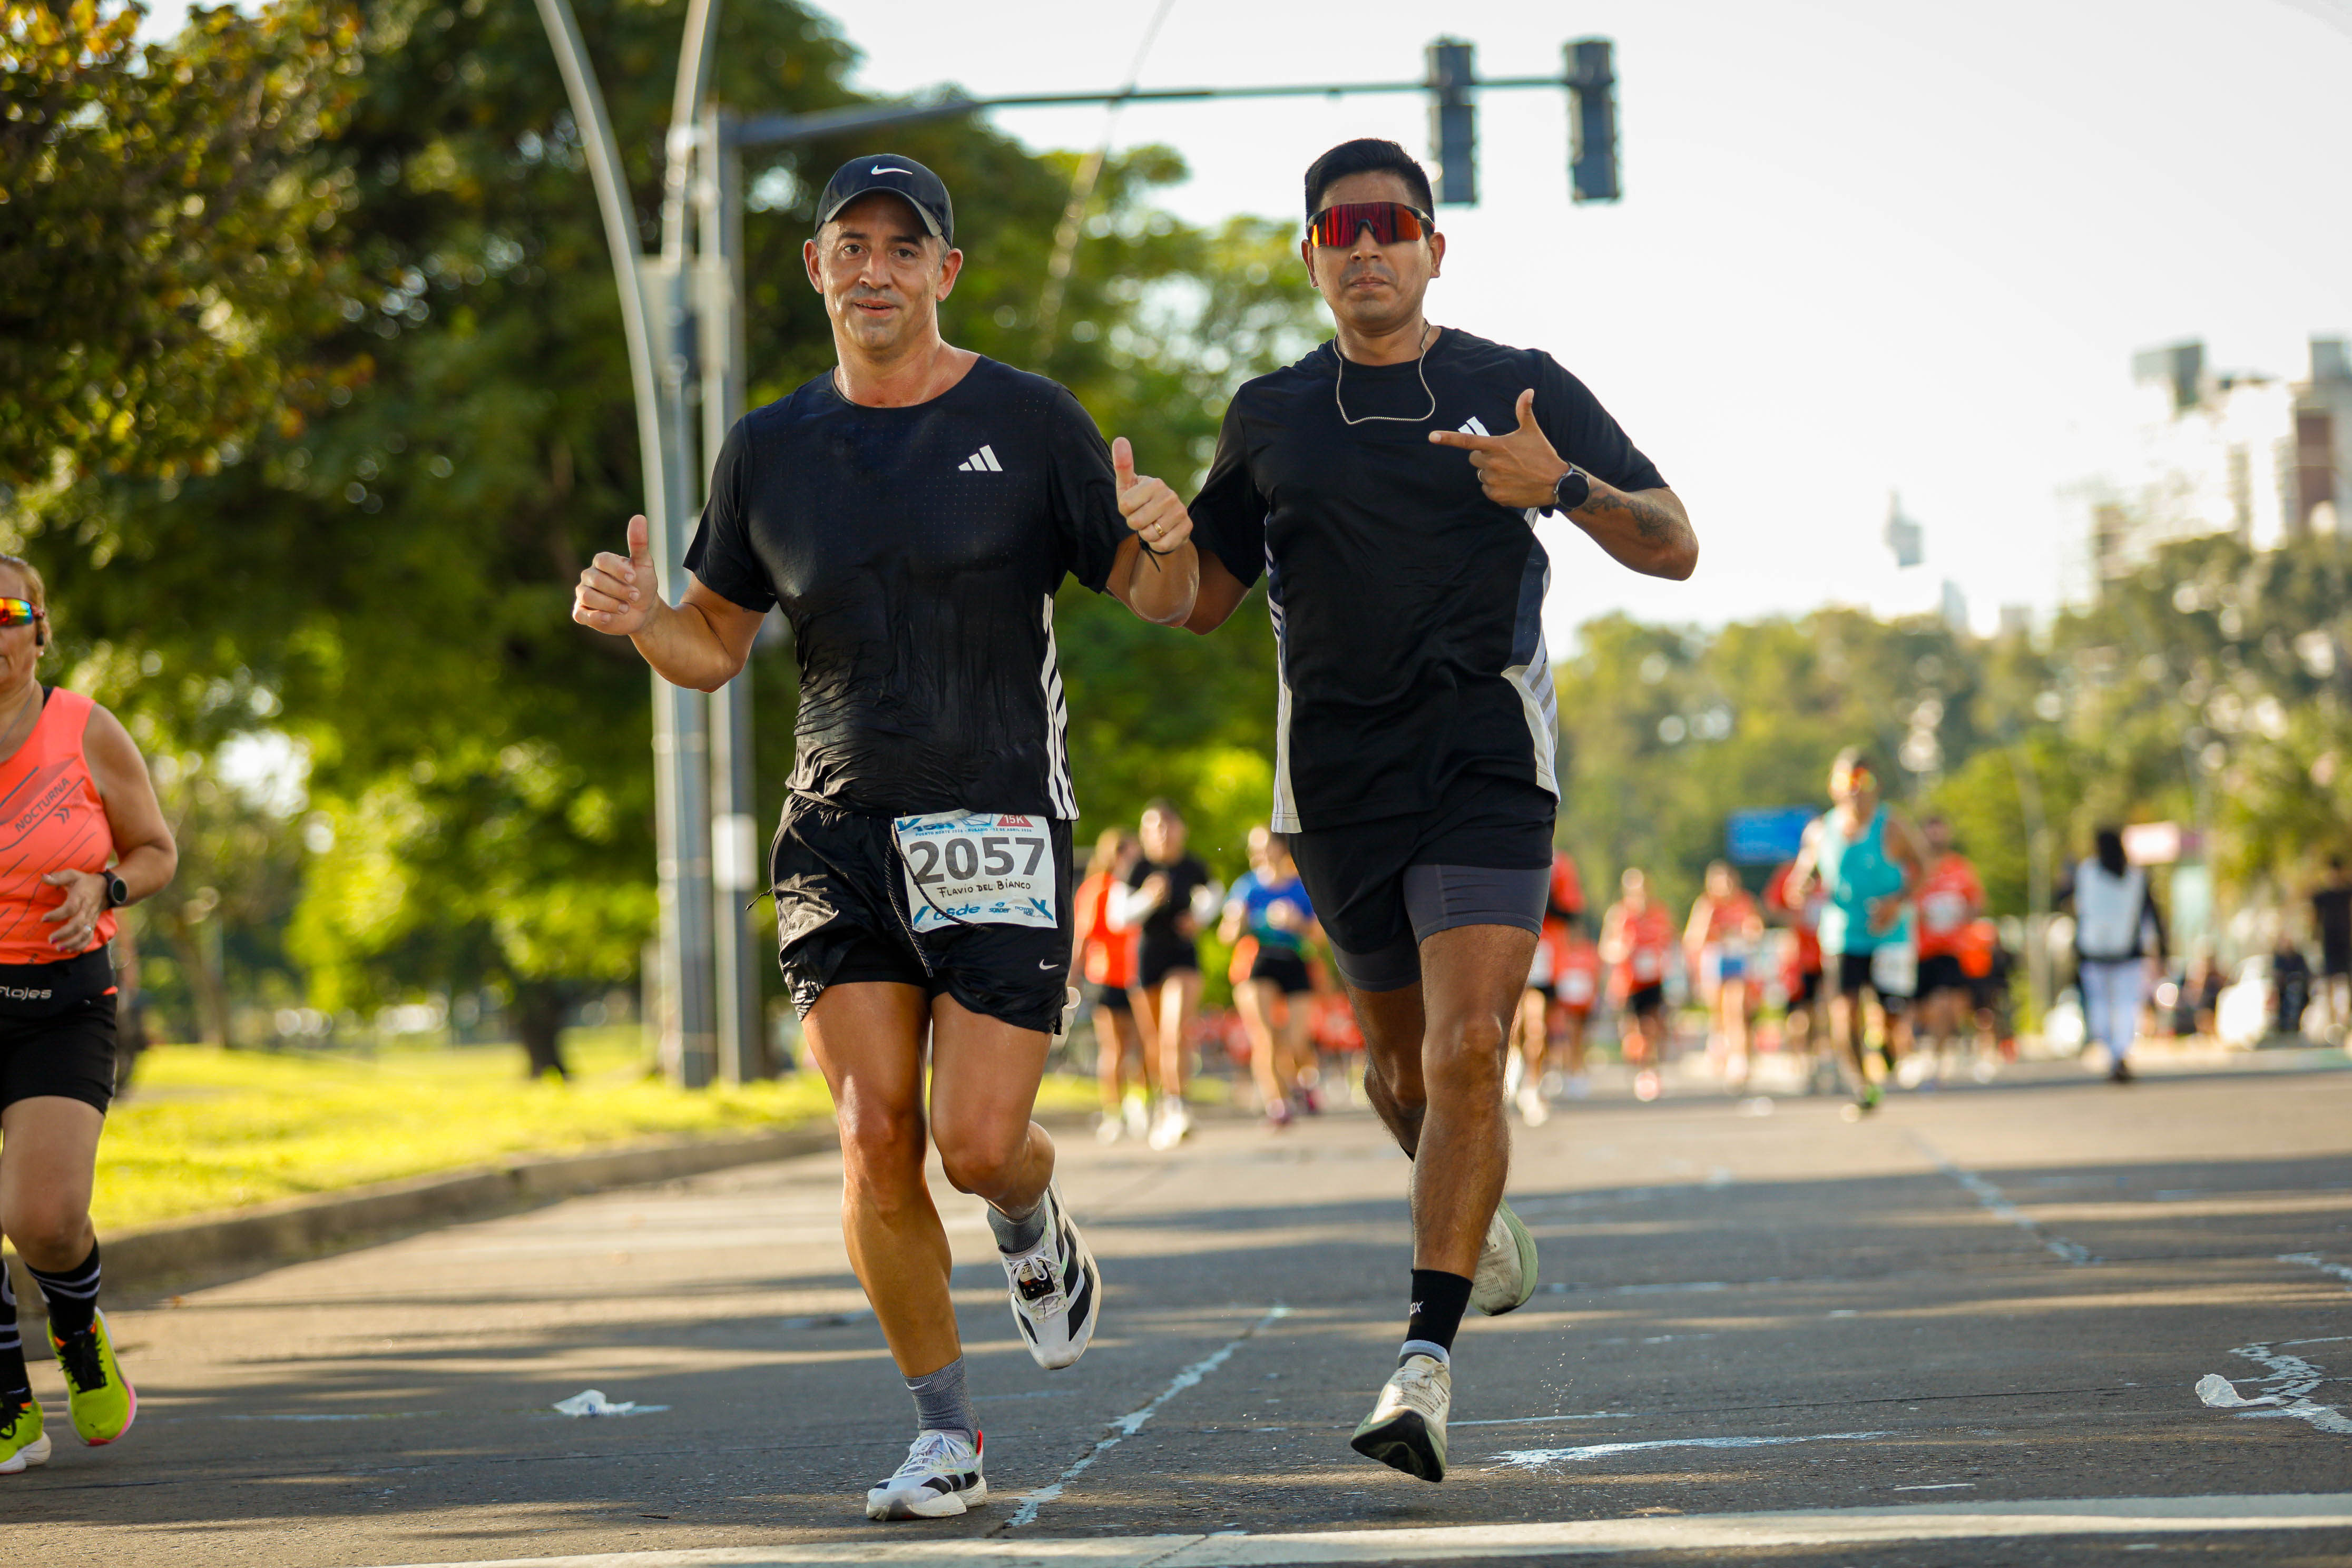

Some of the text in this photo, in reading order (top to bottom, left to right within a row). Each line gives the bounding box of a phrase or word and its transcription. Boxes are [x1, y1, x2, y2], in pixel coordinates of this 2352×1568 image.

[15, 778, 70, 831] NOCTURNA
[1004, 815, 1025, 824] 15K
[909, 837, 1045, 886] 2057
[976, 884, 993, 892] DEL
